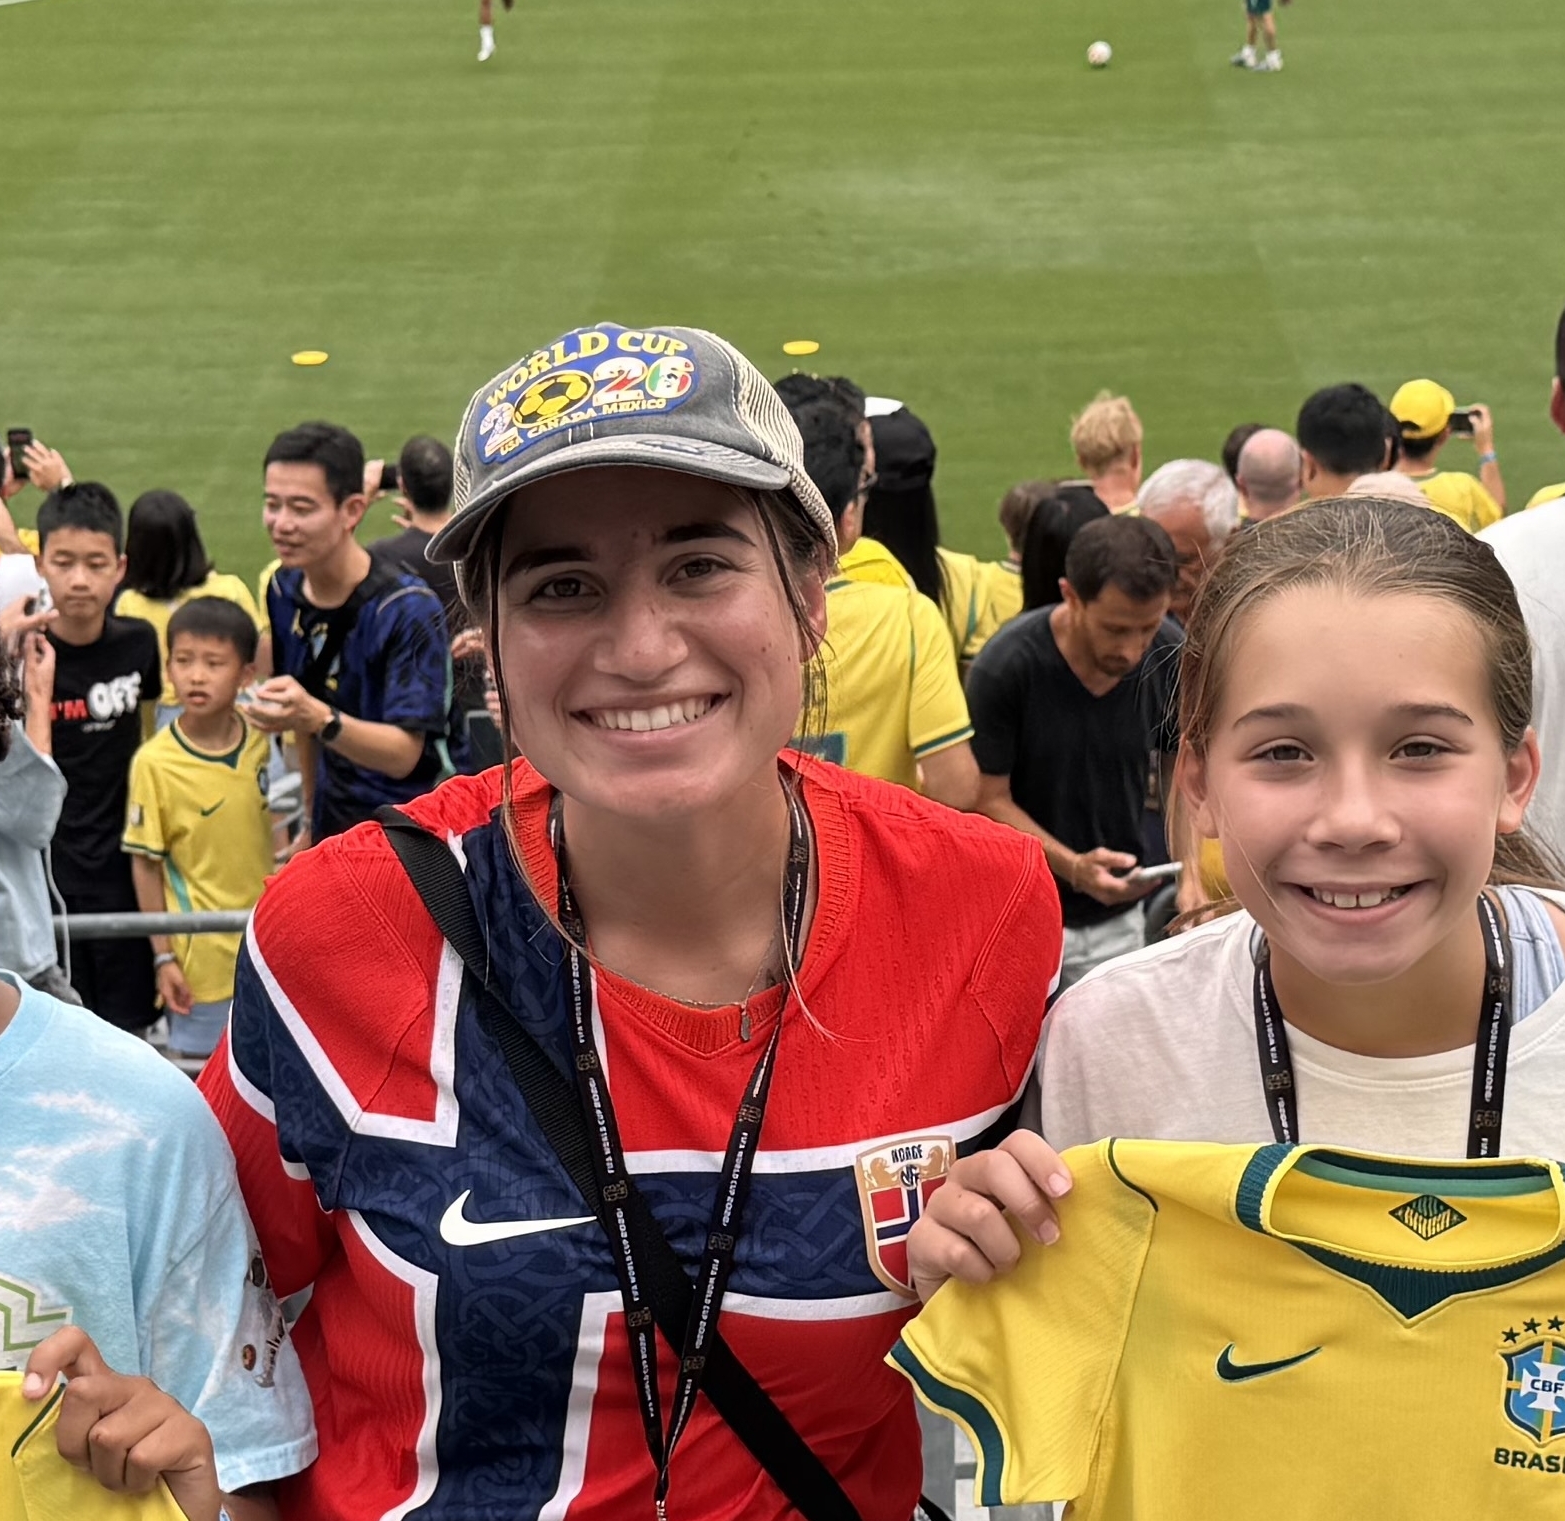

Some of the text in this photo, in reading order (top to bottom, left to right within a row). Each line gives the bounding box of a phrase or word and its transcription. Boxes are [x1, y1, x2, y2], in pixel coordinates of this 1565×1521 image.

[486, 331, 688, 408] WORLD CUP
[500, 398, 666, 455] USA CANADA MEXICO
[1492, 1003, 1502, 1020] FIFA
[891, 1144, 922, 1163] NORGE
[1530, 1378, 1564, 1394] CBF
